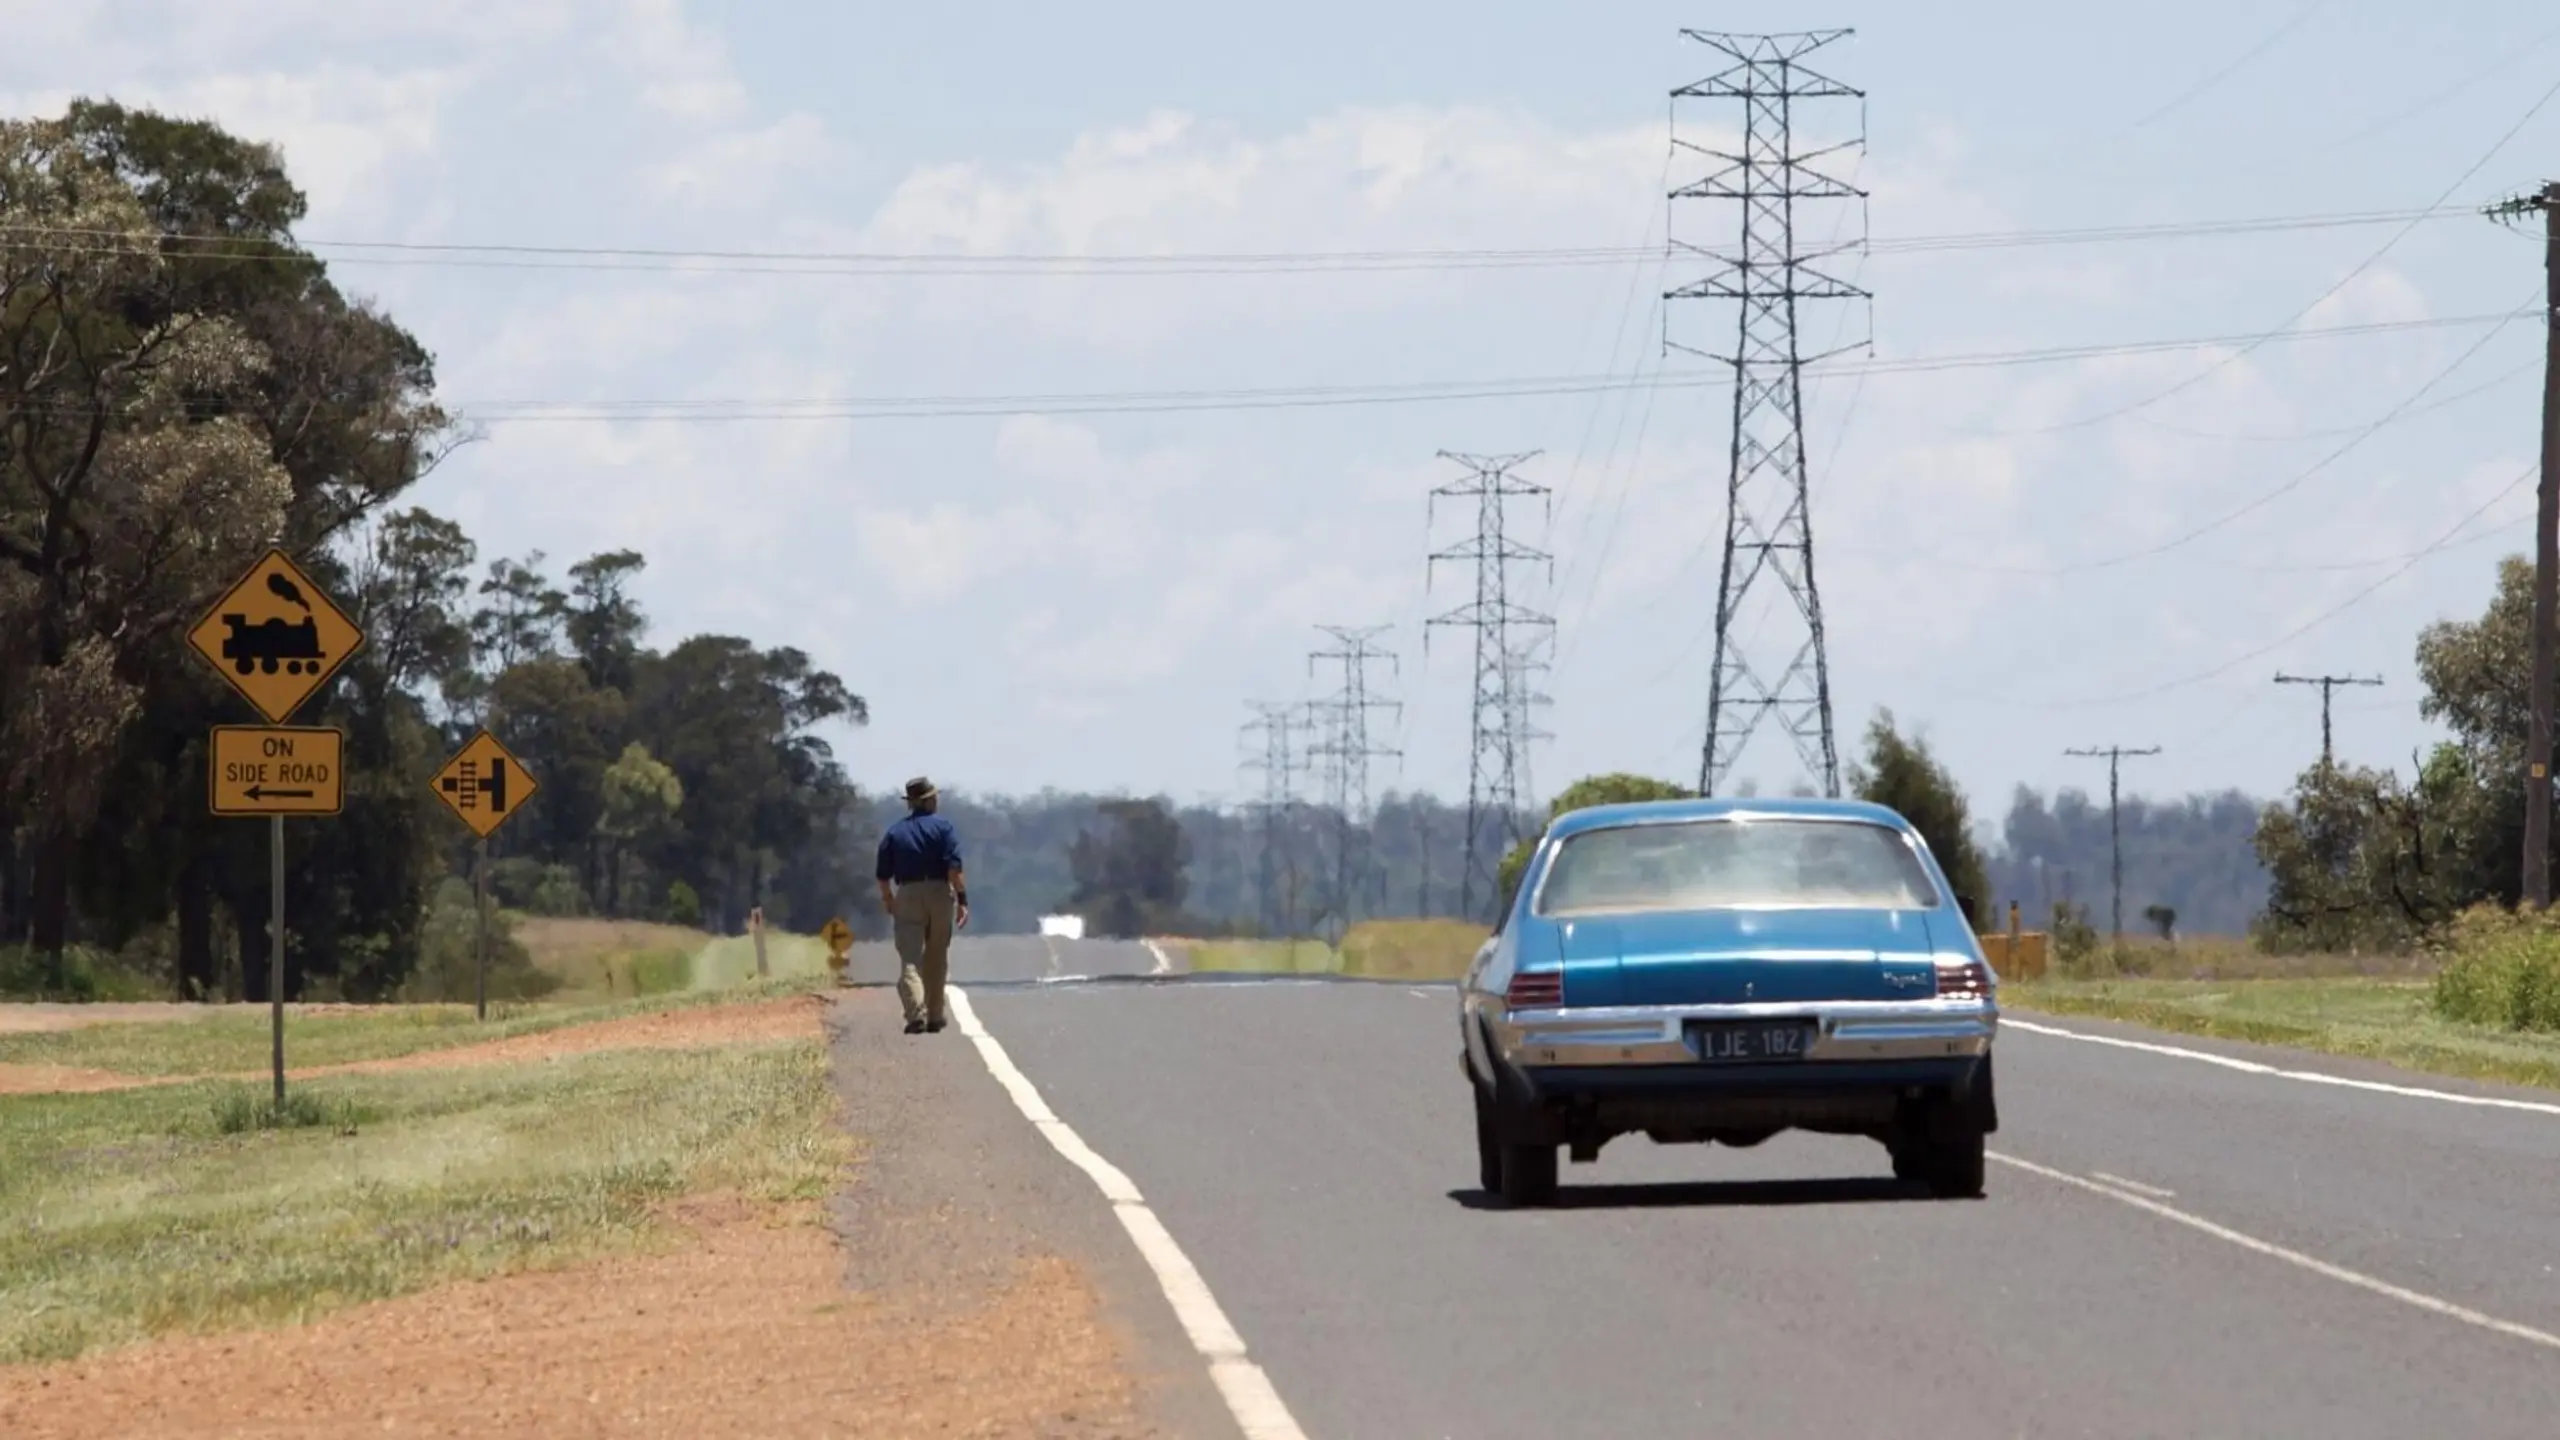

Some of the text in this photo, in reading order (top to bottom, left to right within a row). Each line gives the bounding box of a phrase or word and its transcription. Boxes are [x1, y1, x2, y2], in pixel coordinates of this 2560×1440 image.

[262, 738, 294, 757] ON
[226, 762, 329, 783] SIDE ROAD
